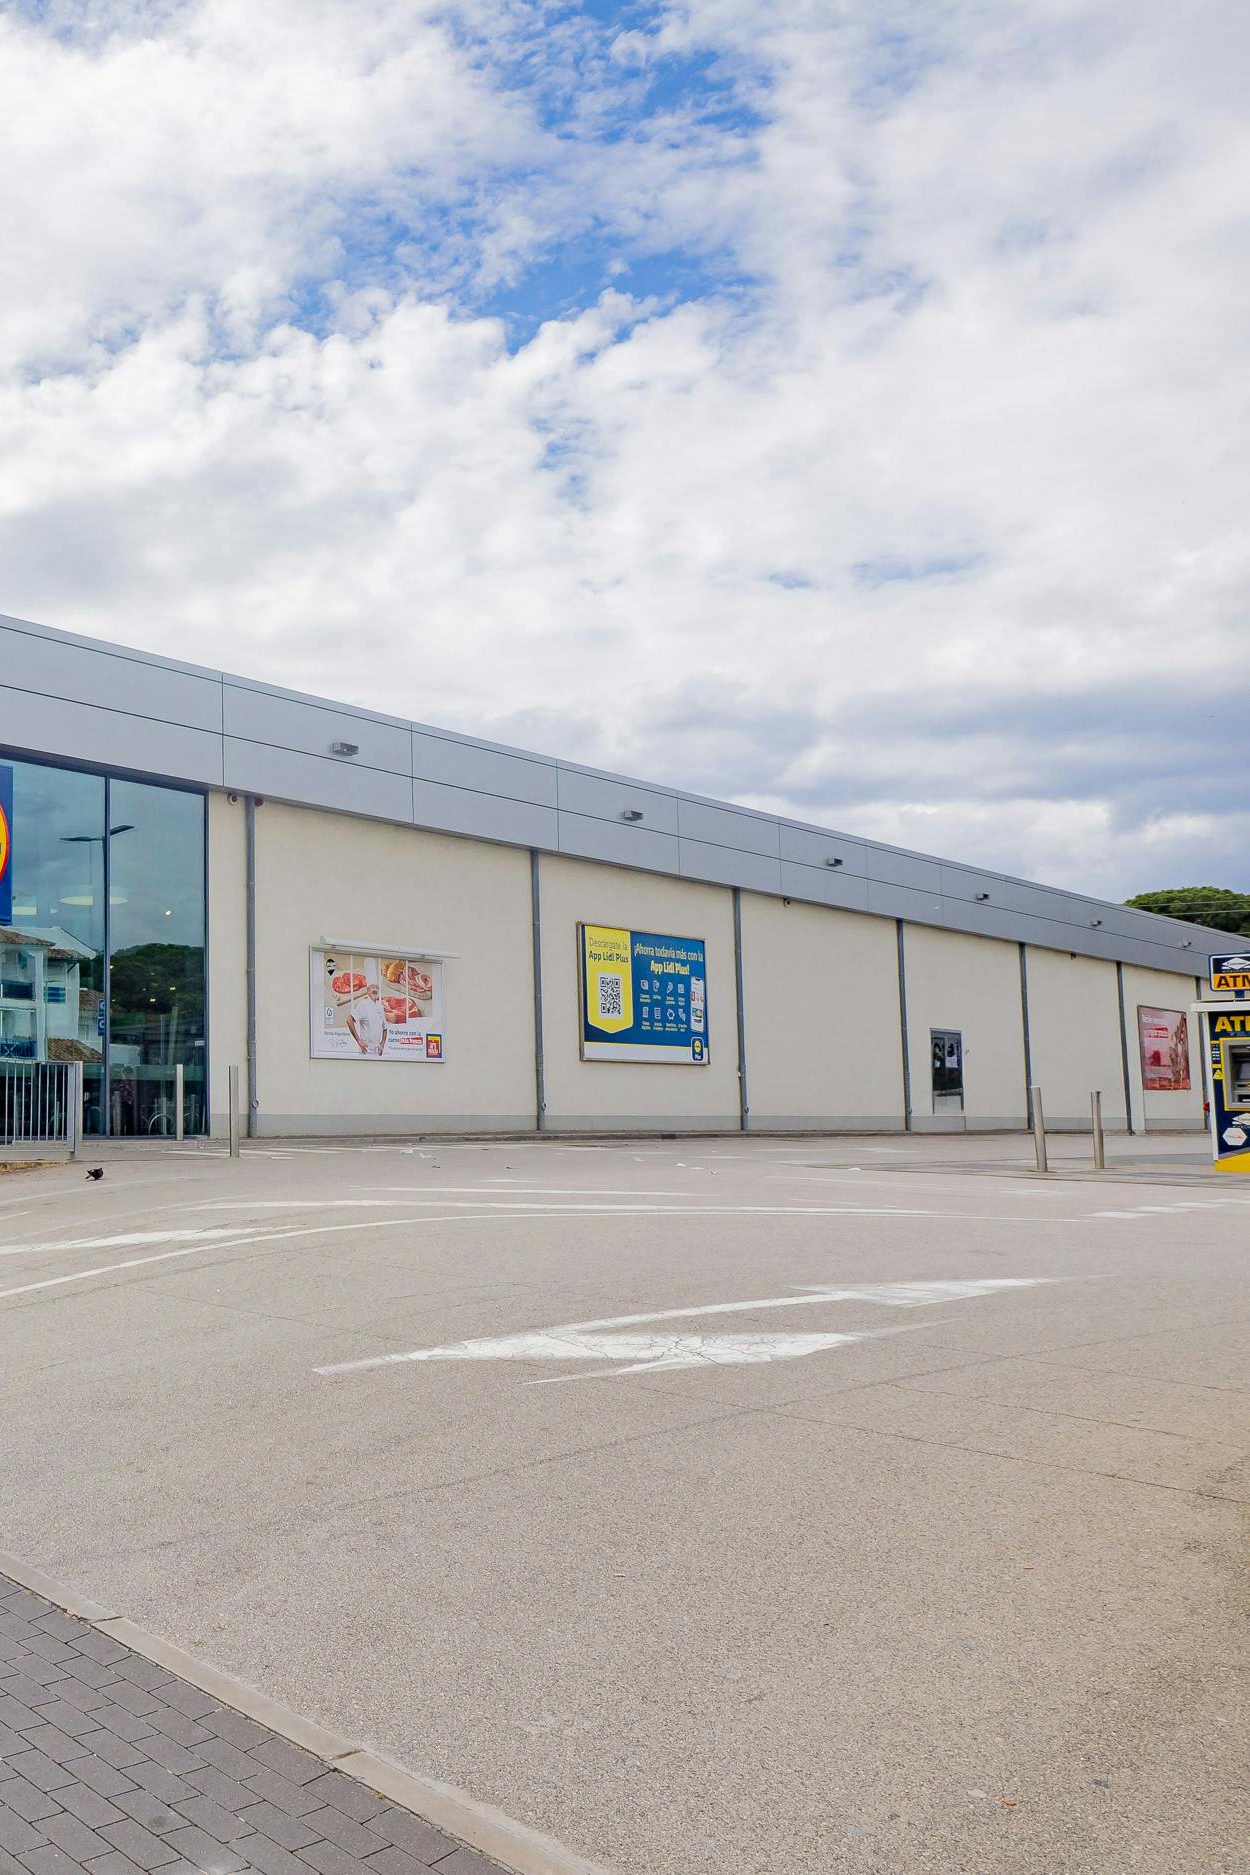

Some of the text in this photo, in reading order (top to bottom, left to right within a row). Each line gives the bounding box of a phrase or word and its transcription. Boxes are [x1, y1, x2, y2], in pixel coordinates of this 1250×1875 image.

[589, 950, 628, 963] App Lidl Plus
[650, 960, 662, 974] App
[663, 961, 675, 973] Lidl
